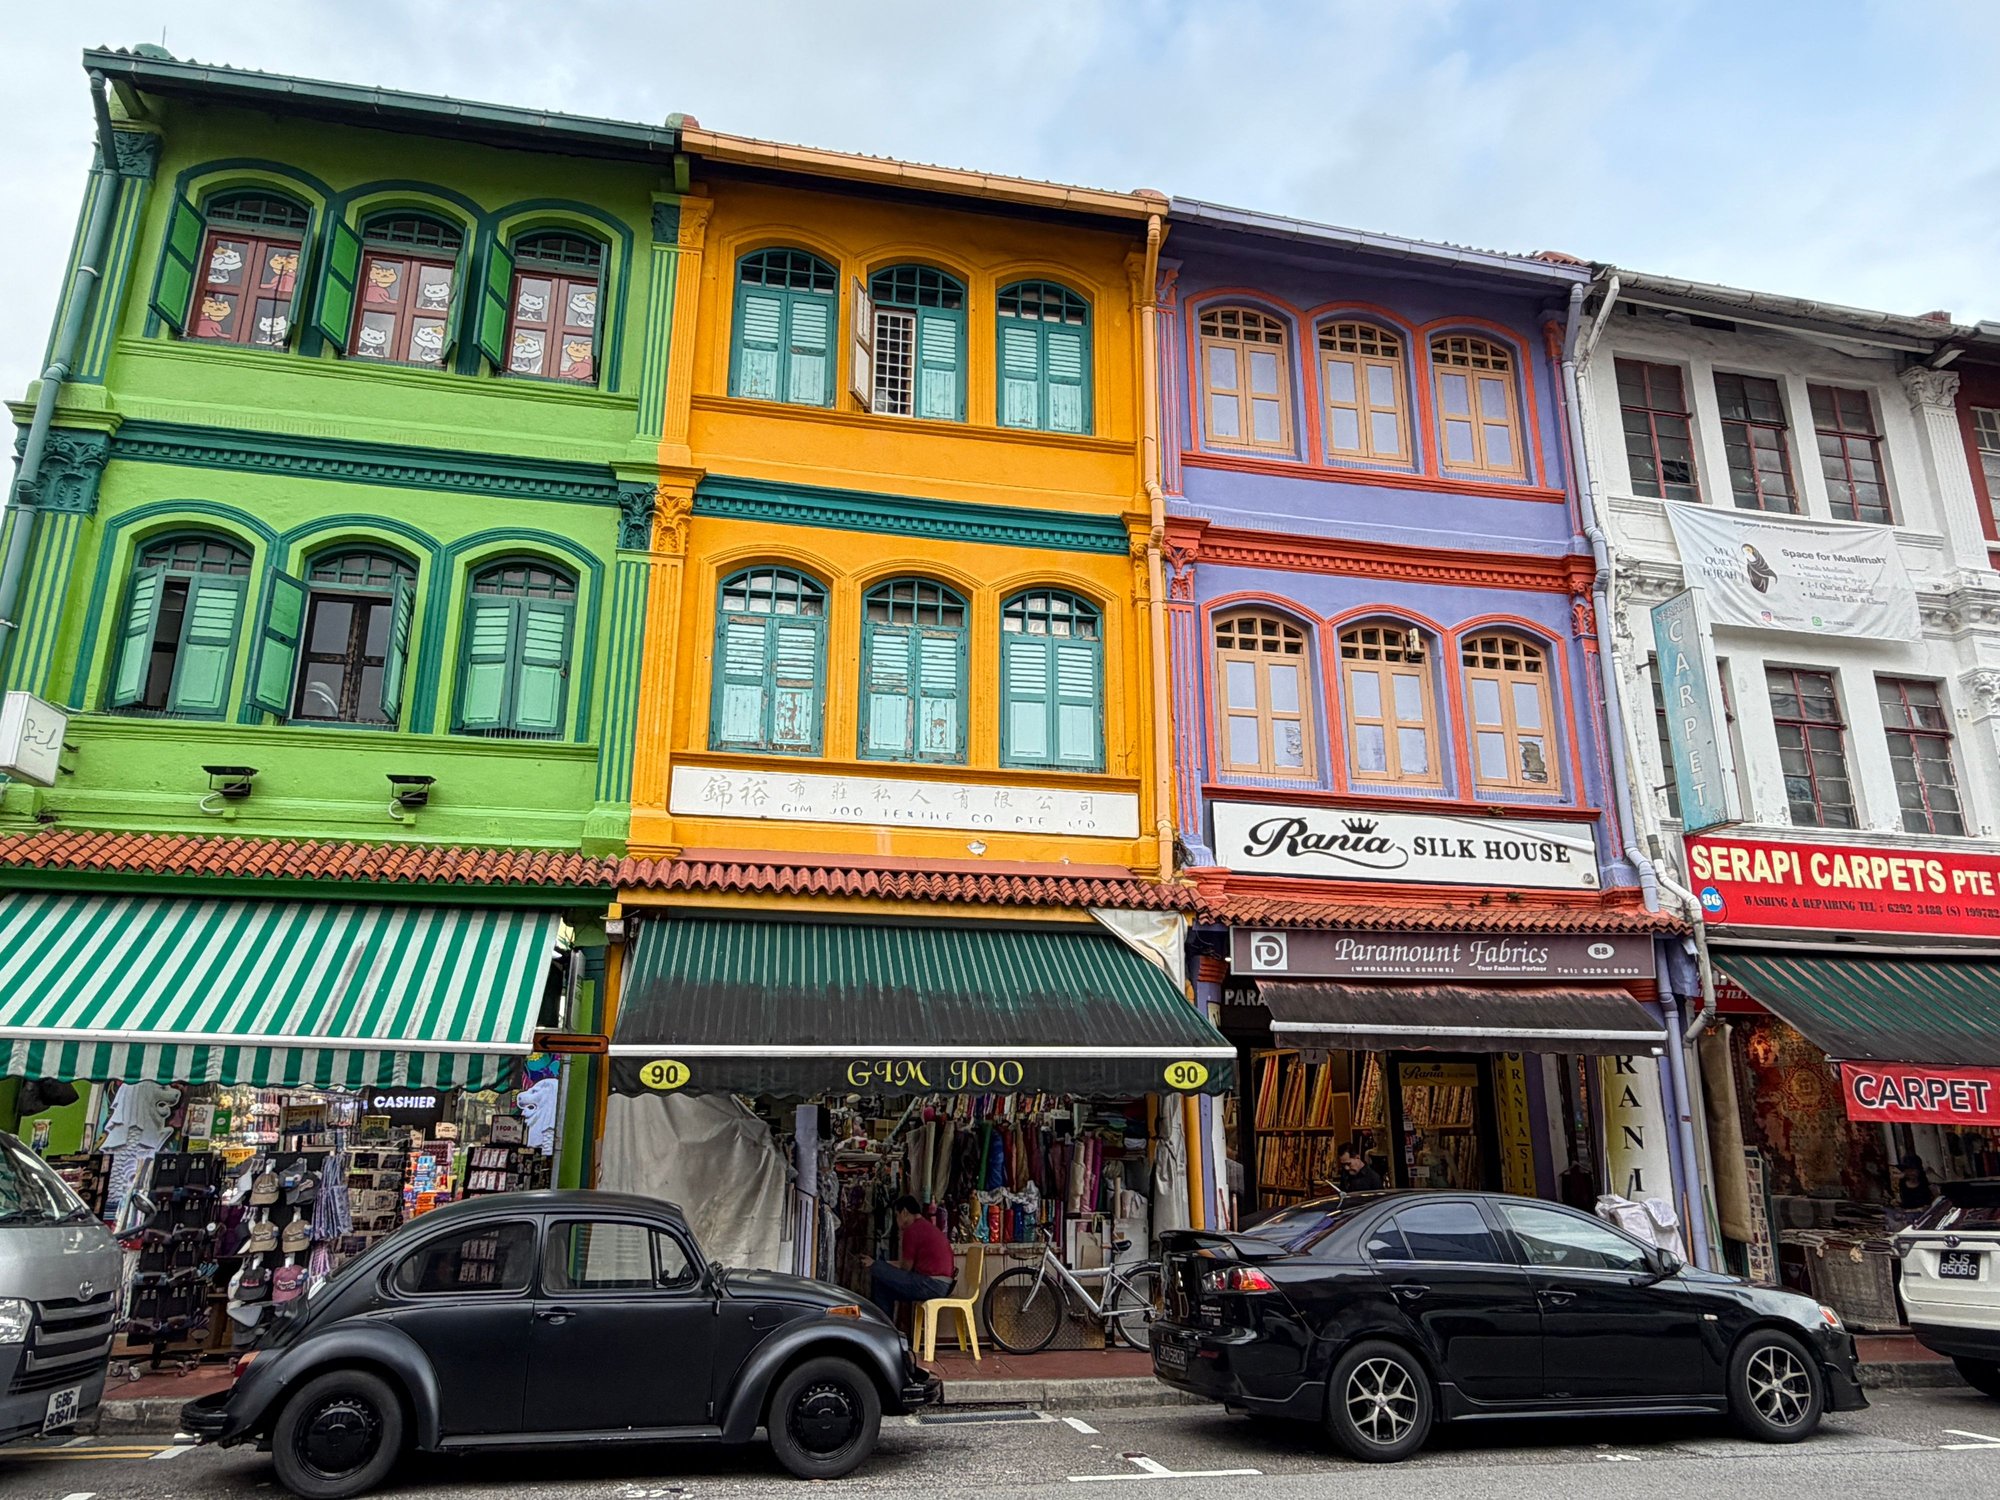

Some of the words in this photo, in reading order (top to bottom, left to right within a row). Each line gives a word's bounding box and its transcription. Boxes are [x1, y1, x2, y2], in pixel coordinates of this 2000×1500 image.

[1782, 548, 1815, 560] Space
[1816, 551, 1831, 561] for
[1833, 553, 1887, 565] Muslimah
[1667, 619, 1708, 807] CARPET
[781, 803, 813, 814] GIM
[829, 805, 864, 817] JOO
[971, 813, 994, 825] CO
[1244, 817, 1408, 869] Rania
[1413, 836, 1477, 859] SILK
[1484, 840, 1571, 864] HOUSE
[1691, 845, 1803, 886] SERAPI
[1810, 852, 1948, 895] CARPETS
[1952, 869, 1996, 897] PTE
[1701, 893, 1722, 907] 86
[1743, 895, 1788, 908] WASHING
[1791, 897, 1801, 908] &
[1802, 898, 1856, 911] REPAIRING
[1858, 901, 1877, 912] TEL
[1945, 905, 1961, 917] (S)
[1335, 938, 1462, 964] Paramount
[1468, 938, 1549, 967] Fabrics
[1593, 946, 1609, 957] 88
[650, 1065, 679, 1085] 90
[847, 1060, 932, 1087] GIM
[947, 1060, 1024, 1091] JOO
[1173, 1065, 1199, 1084] 90
[373, 1095, 436, 1109] CASHIER
[1511, 1068, 1527, 1138] RANIA
[1853, 1074, 1991, 1114] CARPET
[1940, 1262, 1978, 1276] 8508G
[1948, 1253, 1971, 1265] SJS
